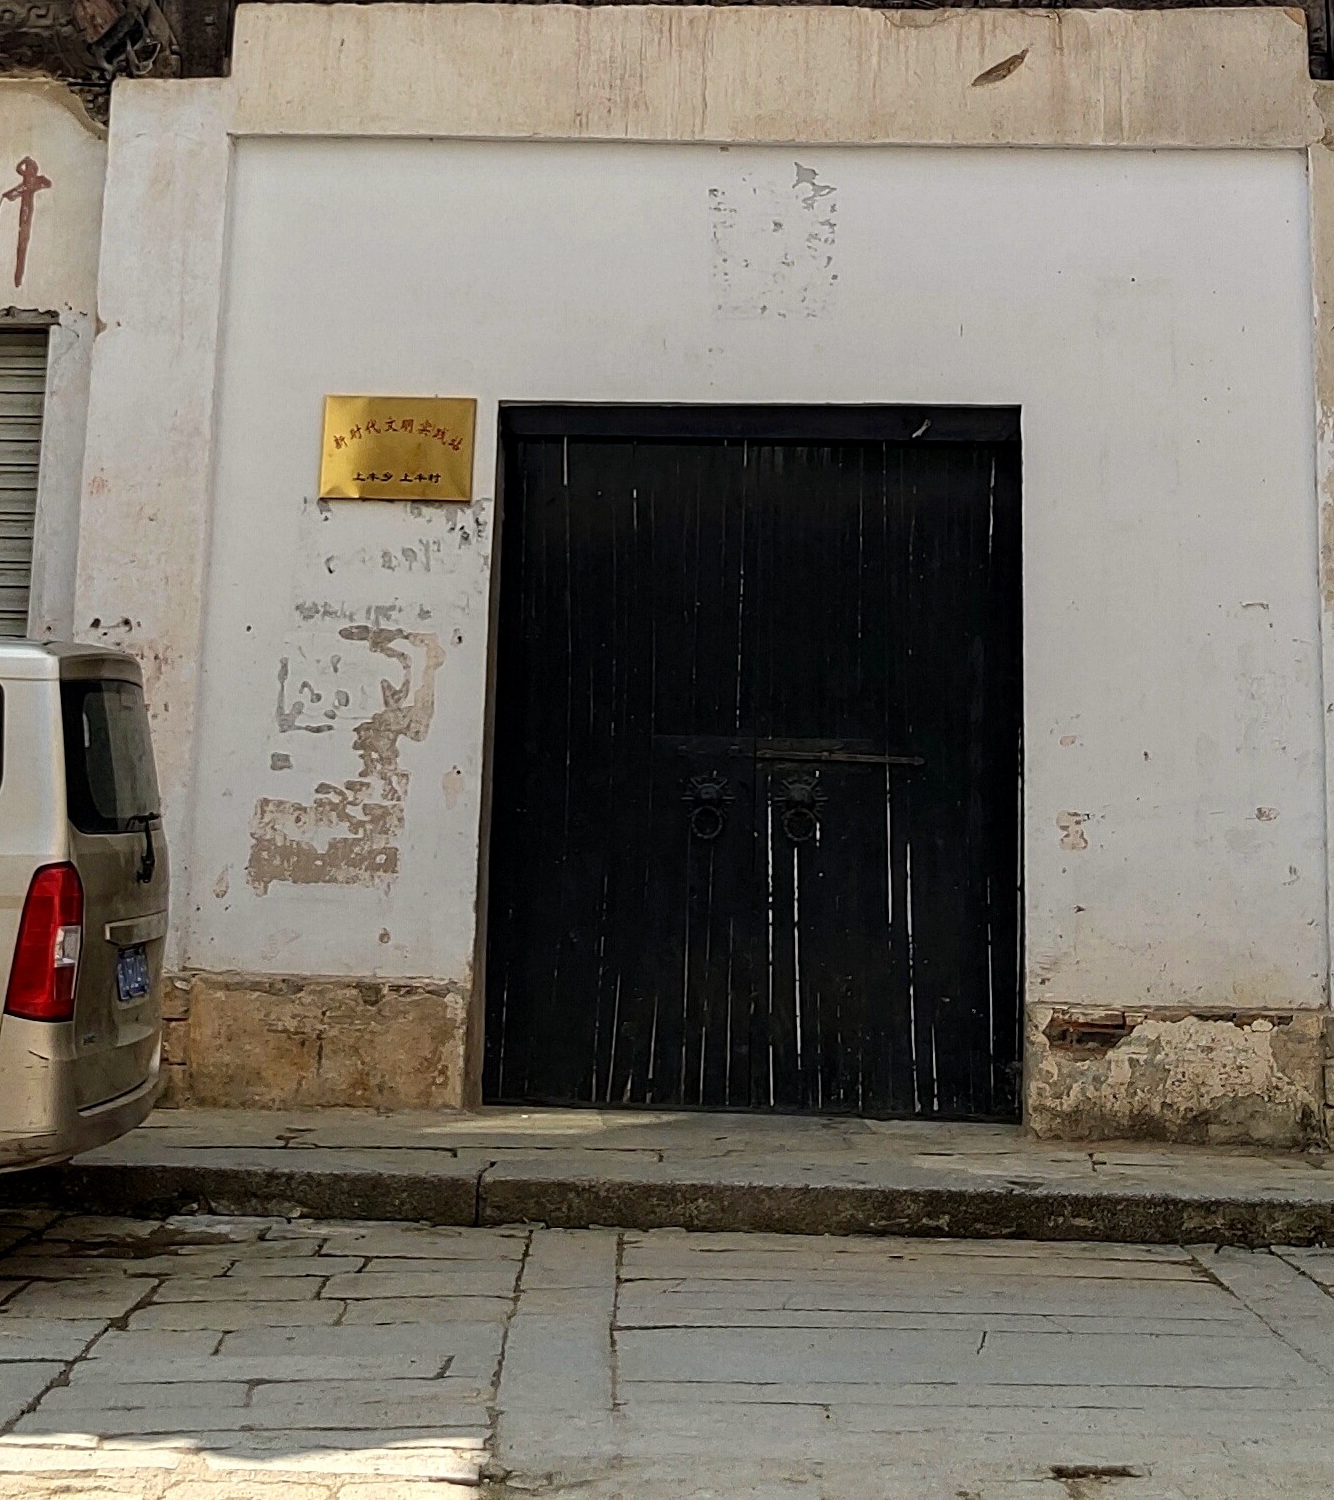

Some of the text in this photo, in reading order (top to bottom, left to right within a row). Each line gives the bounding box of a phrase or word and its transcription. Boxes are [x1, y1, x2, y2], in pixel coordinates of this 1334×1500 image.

[332, 416, 464, 452] 新时代文明实践站
